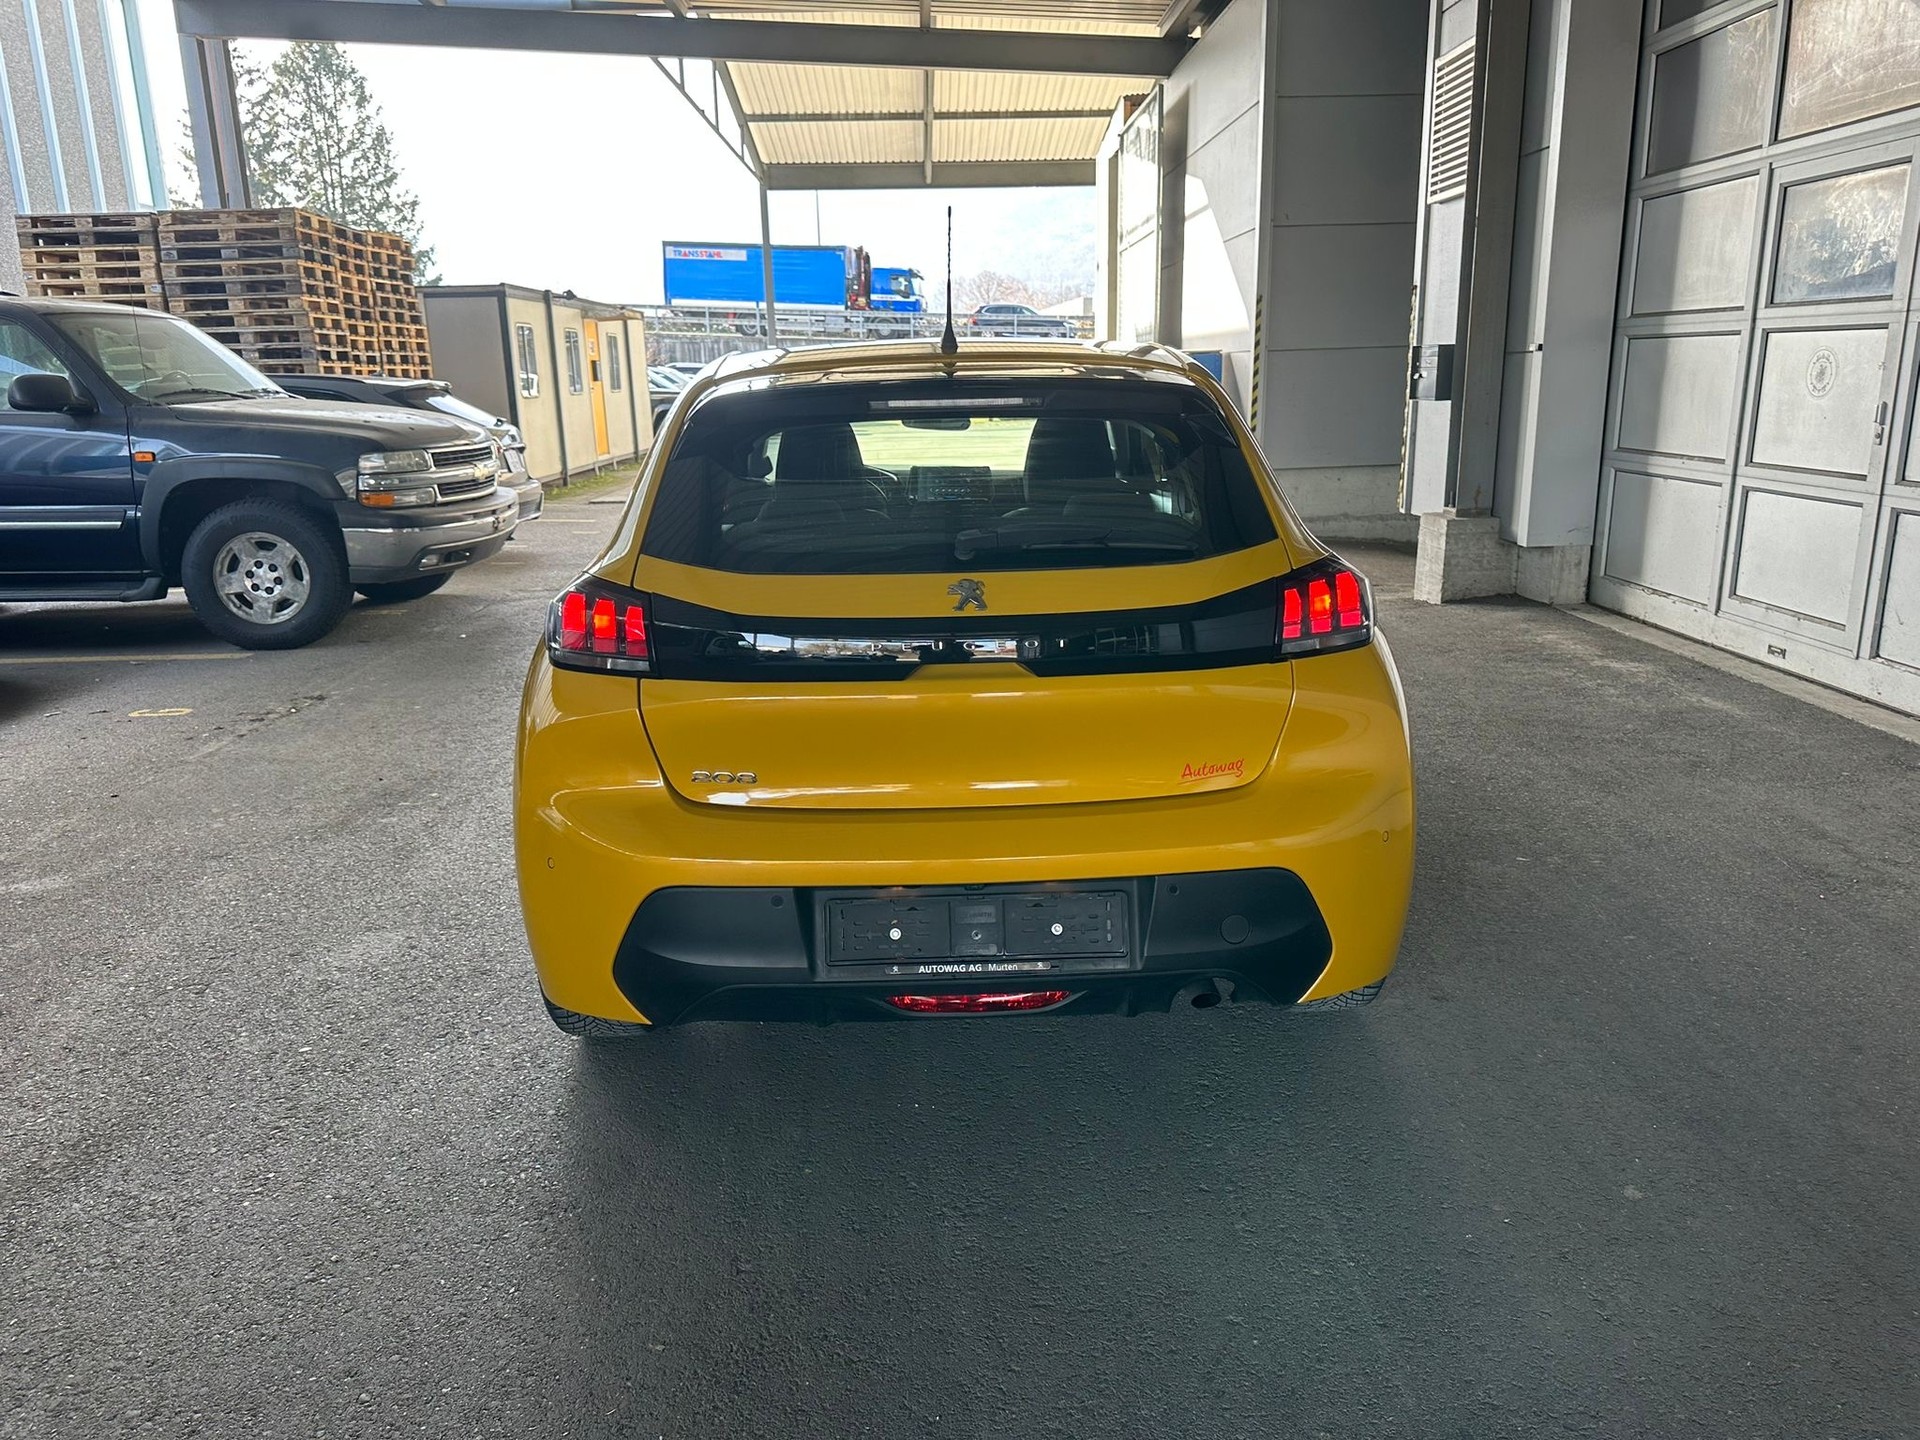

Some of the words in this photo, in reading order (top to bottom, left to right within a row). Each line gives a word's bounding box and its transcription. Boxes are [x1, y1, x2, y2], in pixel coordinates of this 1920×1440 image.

[673, 250, 723, 258] TRANSSTAHL
[871, 639, 1068, 652] PEUGEOT
[1181, 758, 1244, 778] Autowag
[691, 770, 757, 784] 208
[918, 964, 966, 974] AUTOWAG
[968, 964, 982, 972] AG
[988, 963, 1018, 971] Murten
